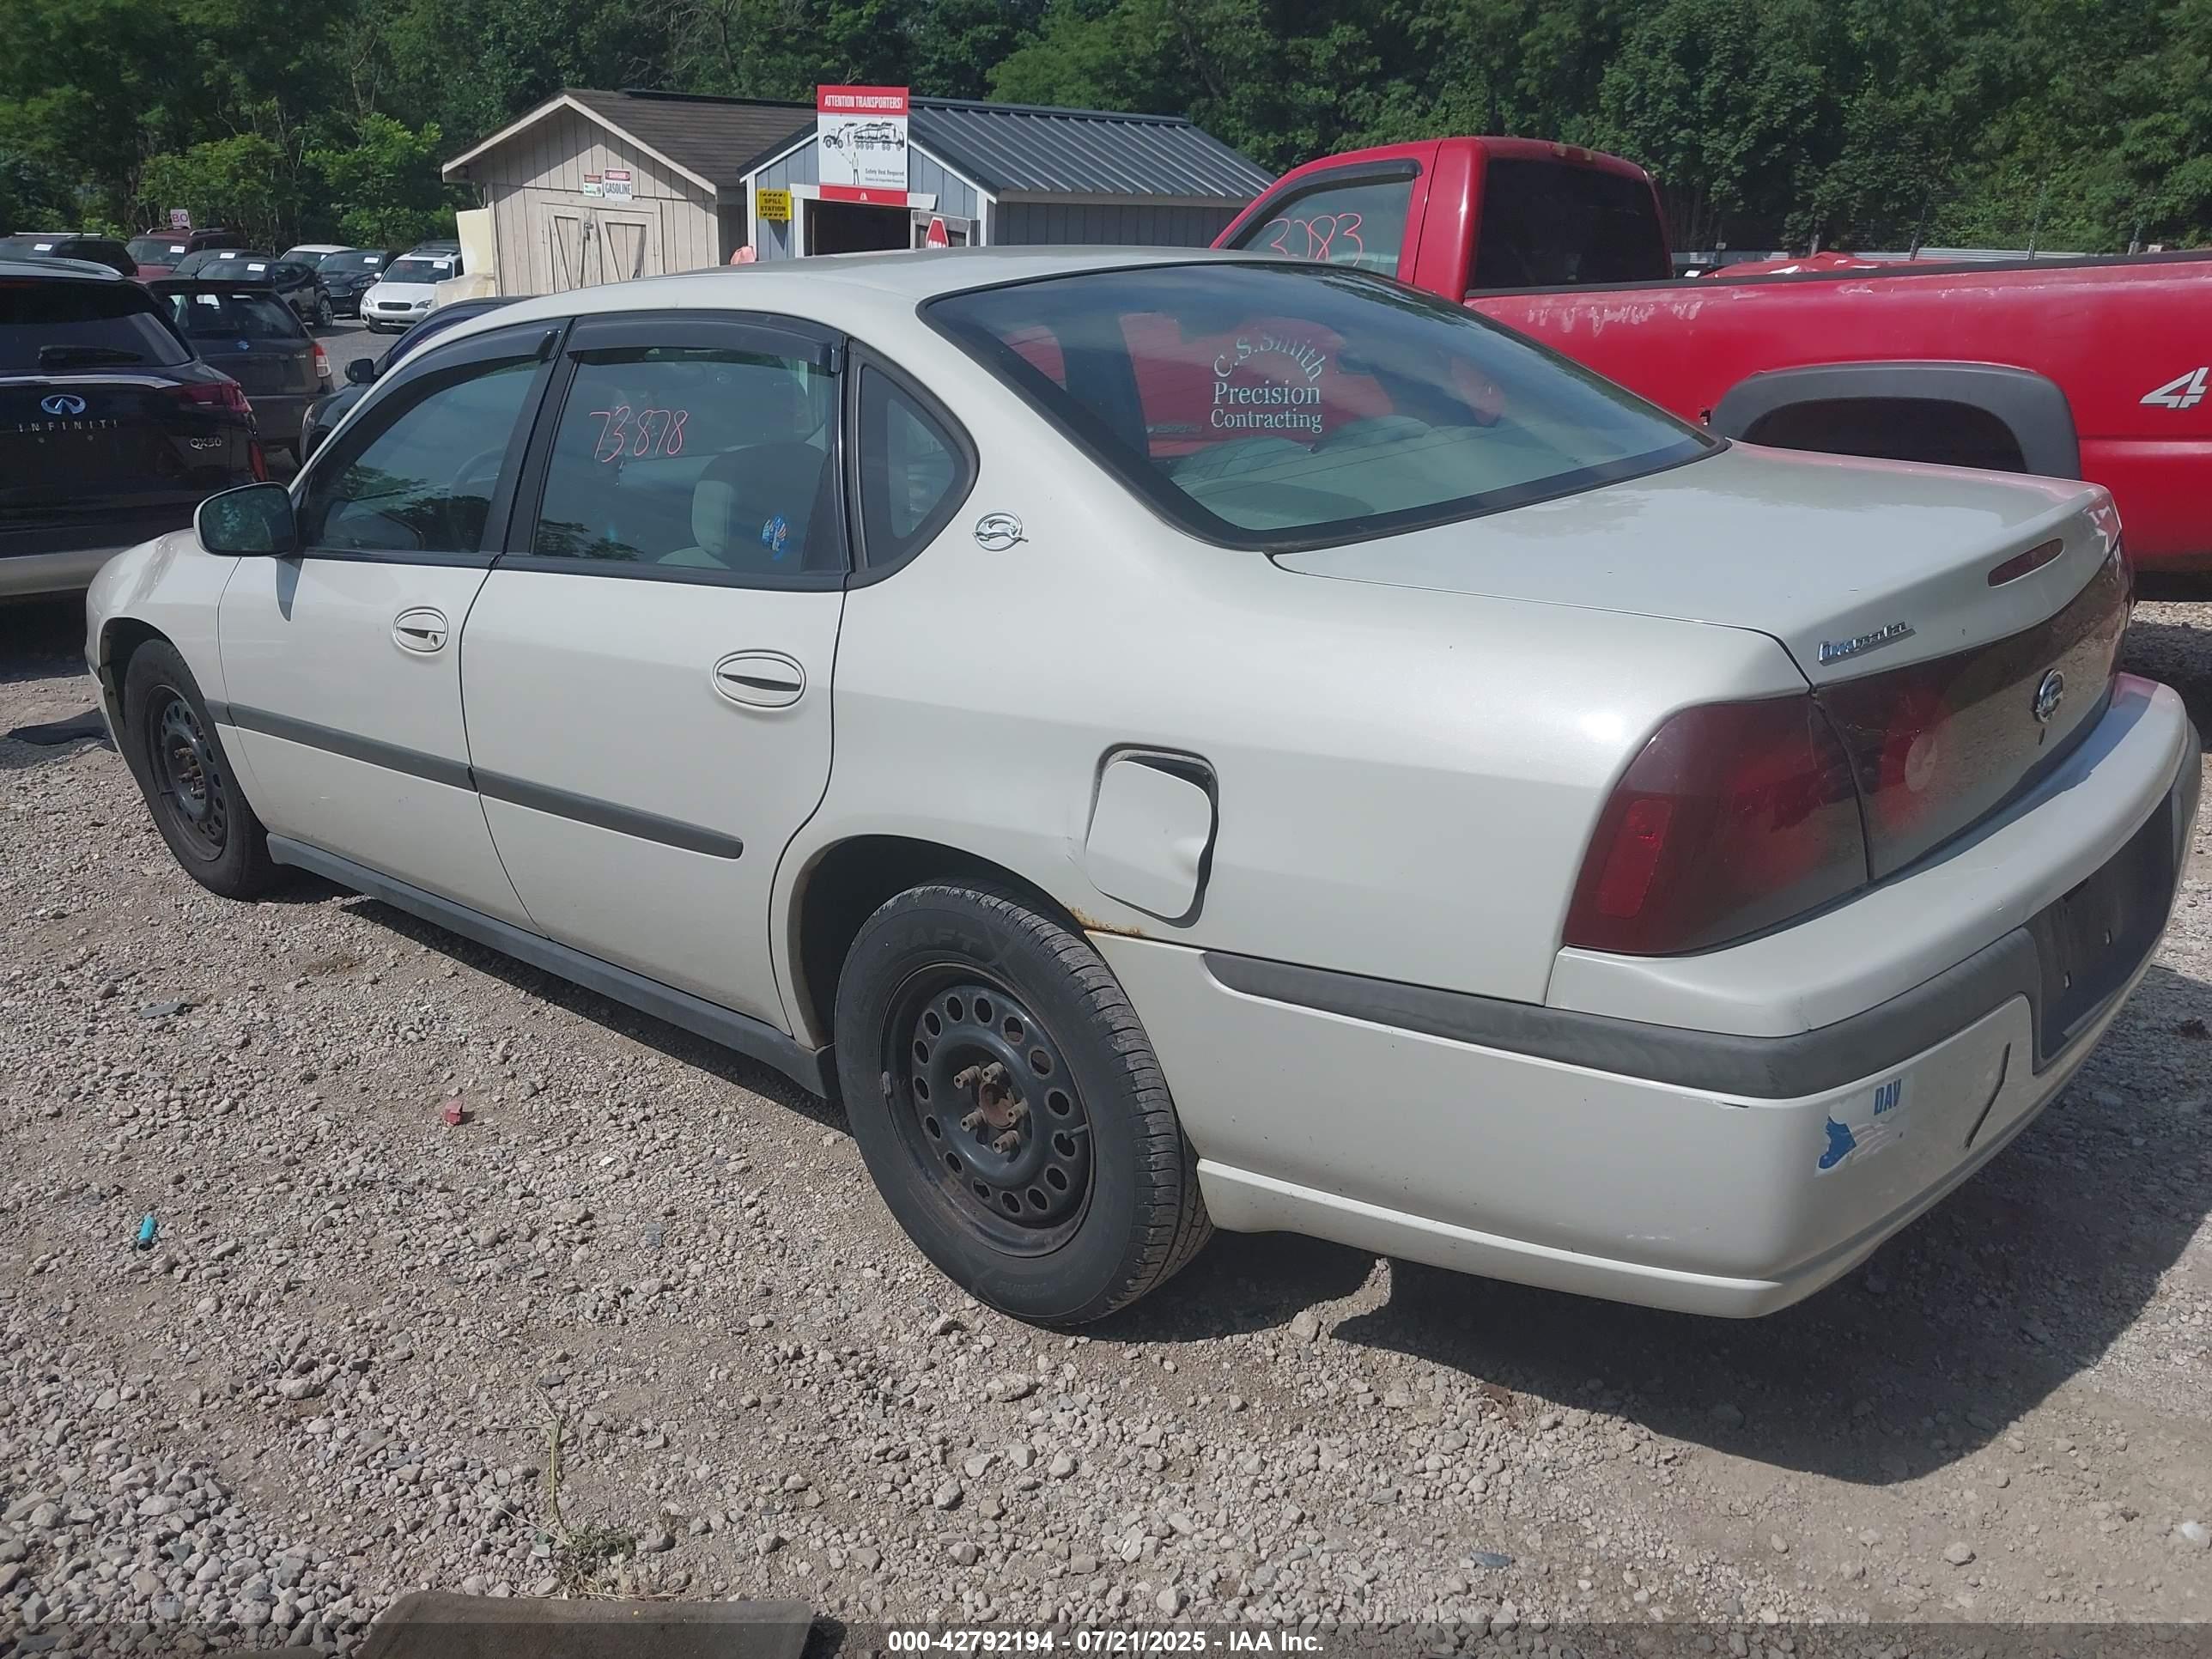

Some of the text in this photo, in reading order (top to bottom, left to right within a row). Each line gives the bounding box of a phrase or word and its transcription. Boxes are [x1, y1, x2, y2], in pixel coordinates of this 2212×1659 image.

[824, 94, 902, 109] ATTENTION TRANSPORTERS!
[605, 182, 631, 195] GASOLINE
[1212, 380, 1322, 404] Precision
[19, 419, 118, 432] INFINITI
[1211, 408, 1323, 434] Contracting
[190, 437, 222, 450] QX50
[589, 405, 689, 463] 73878
[1874, 1079, 1902, 1116] DAV
